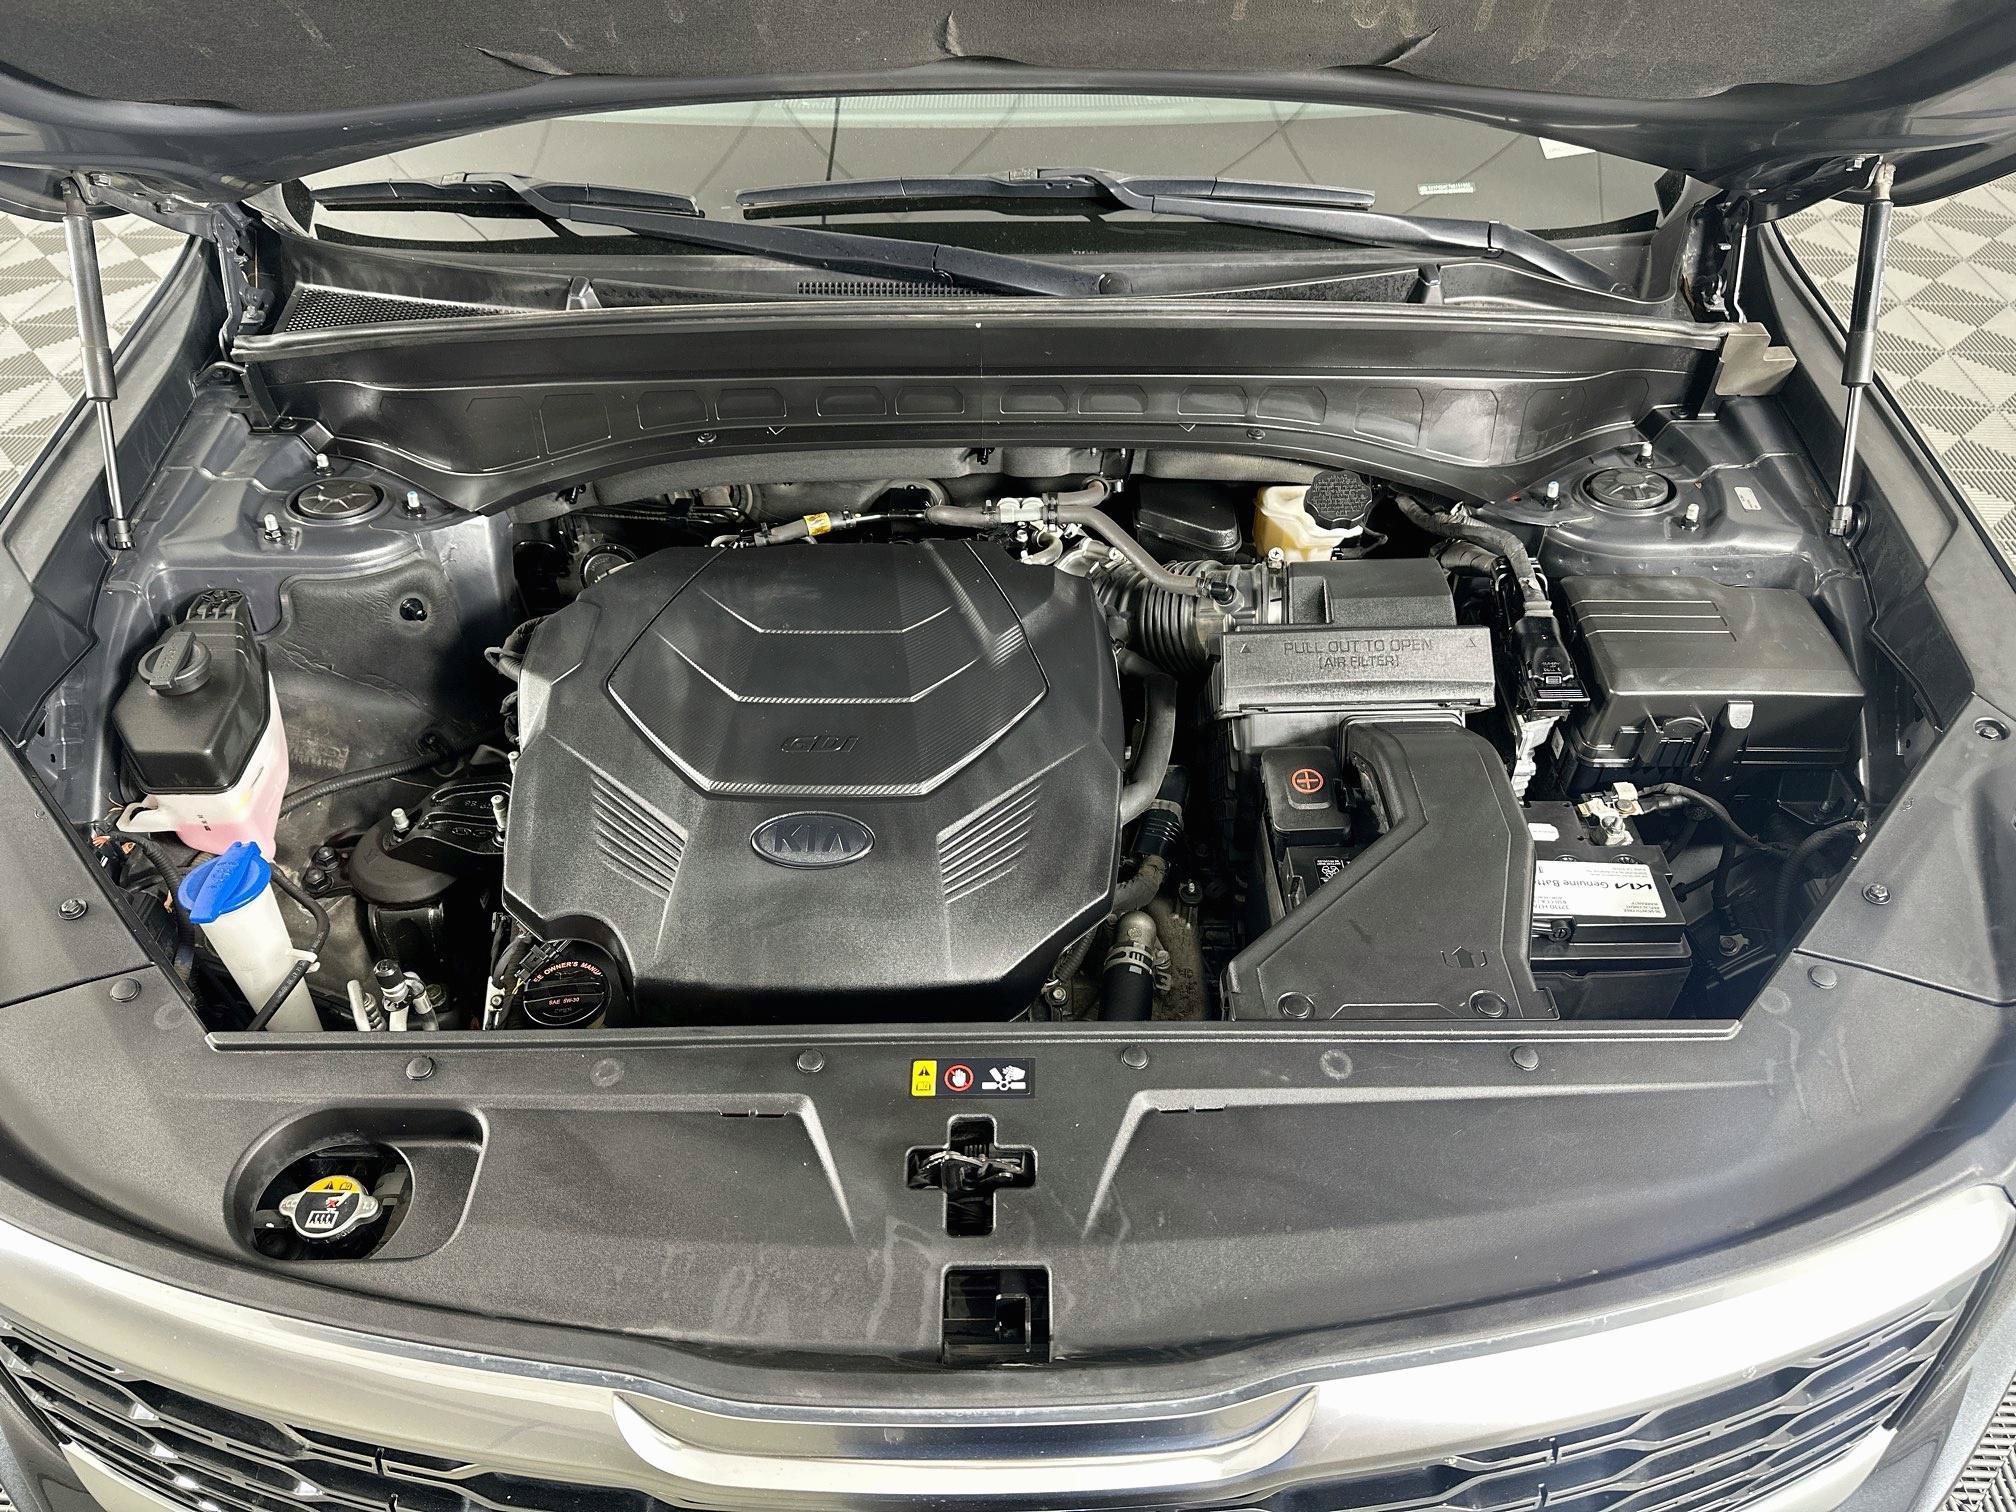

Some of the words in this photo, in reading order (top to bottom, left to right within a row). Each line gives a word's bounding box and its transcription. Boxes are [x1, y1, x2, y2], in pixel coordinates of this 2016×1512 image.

[1283, 641, 1323, 654] PULL
[1328, 640, 1360, 653] OUT
[1362, 639, 1385, 652] TO
[1389, 638, 1433, 652] OPEN
[1318, 656, 1346, 669] (AIR
[1350, 654, 1400, 667] FILTER)
[780, 735, 861, 752] GDI
[773, 823, 852, 852] KIA
[1533, 879, 1559, 888] Batt
[1562, 880, 1609, 889] Genuine
[544, 961, 578, 975] OWNER'S
